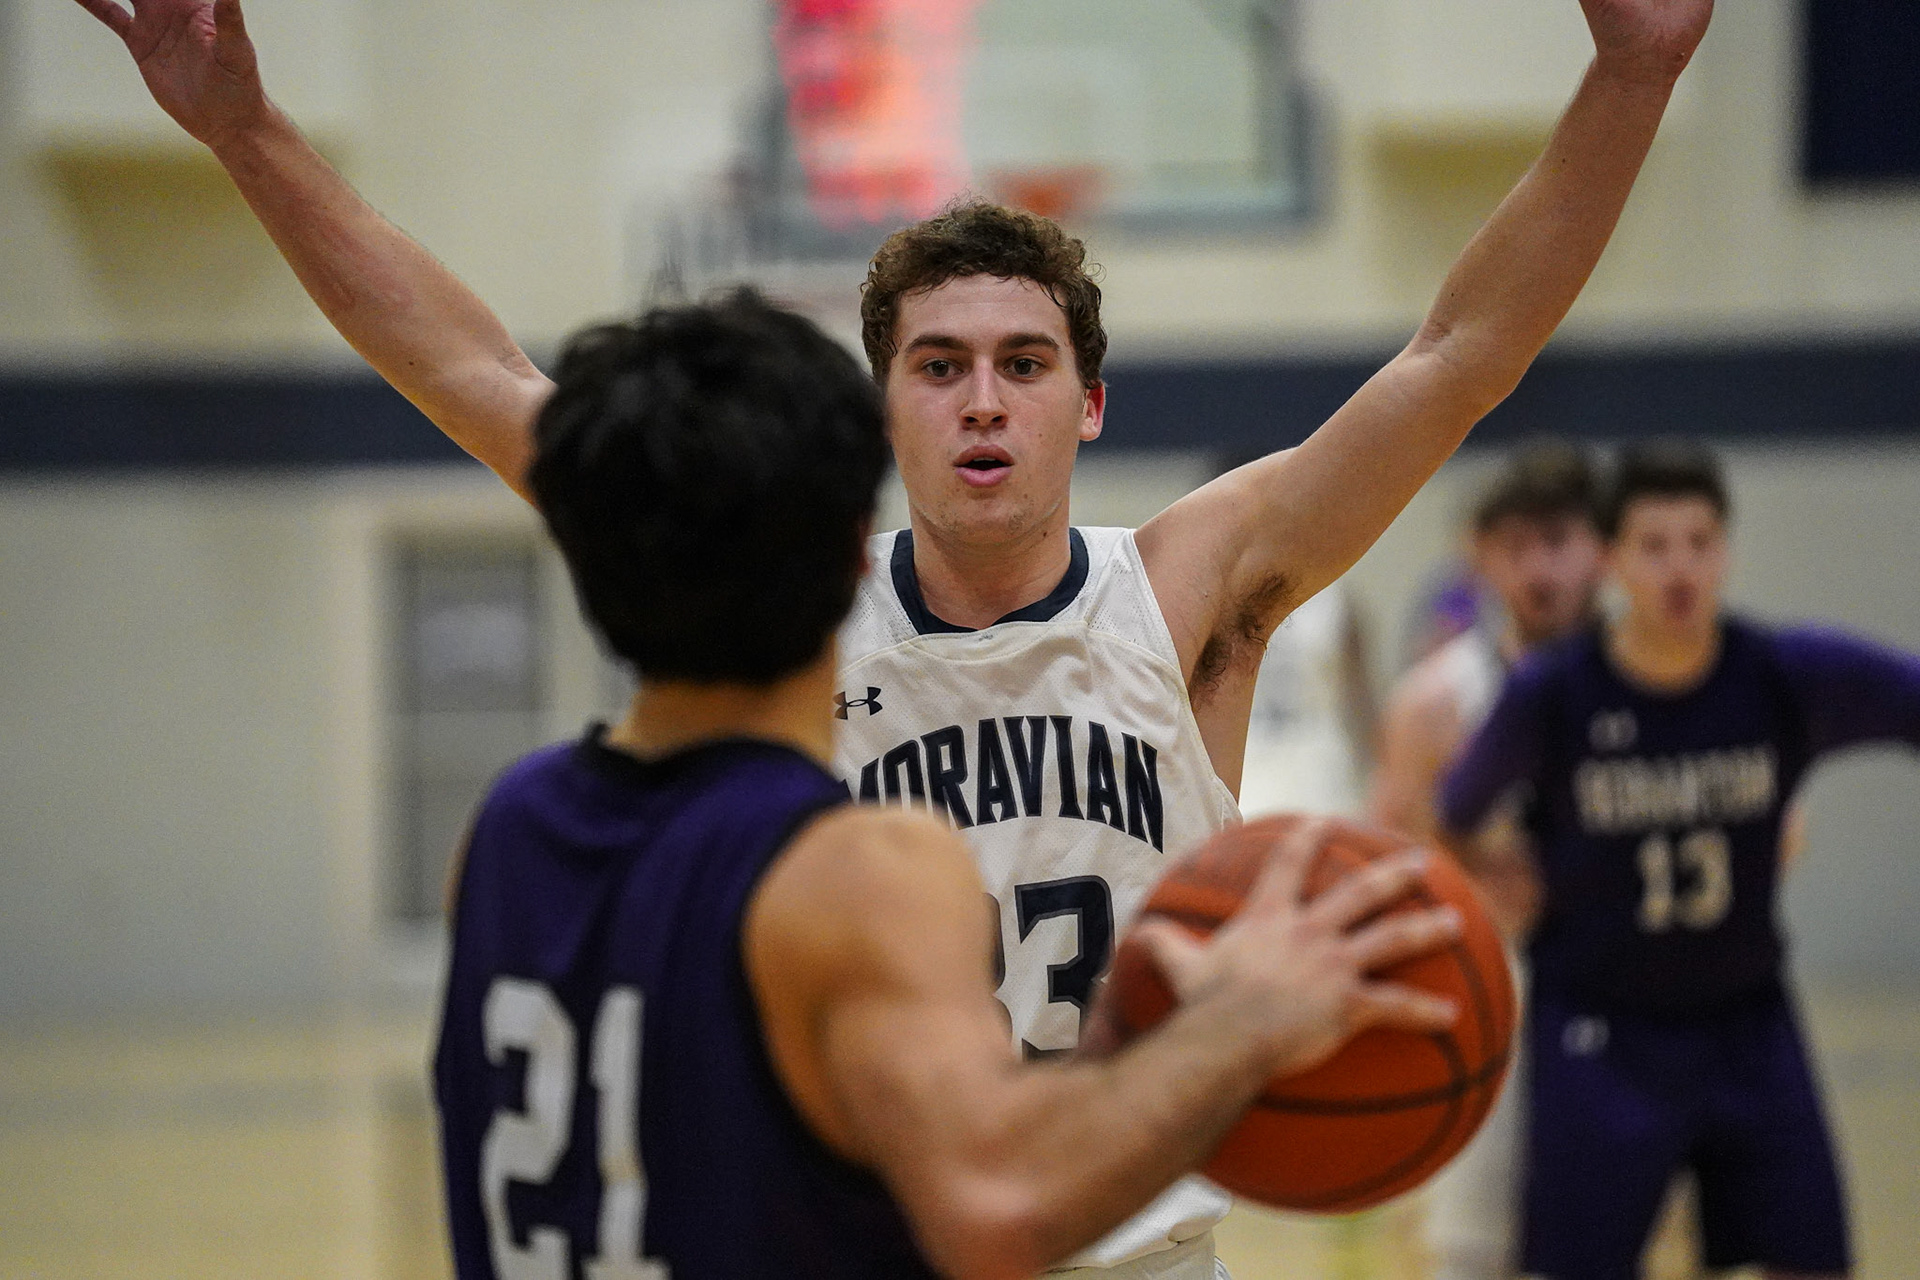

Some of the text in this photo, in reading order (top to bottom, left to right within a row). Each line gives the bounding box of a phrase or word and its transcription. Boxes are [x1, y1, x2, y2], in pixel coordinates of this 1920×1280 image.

[985, 874, 1116, 1063] 3
[1638, 832, 1733, 930] 13
[480, 975, 672, 1280] 21
